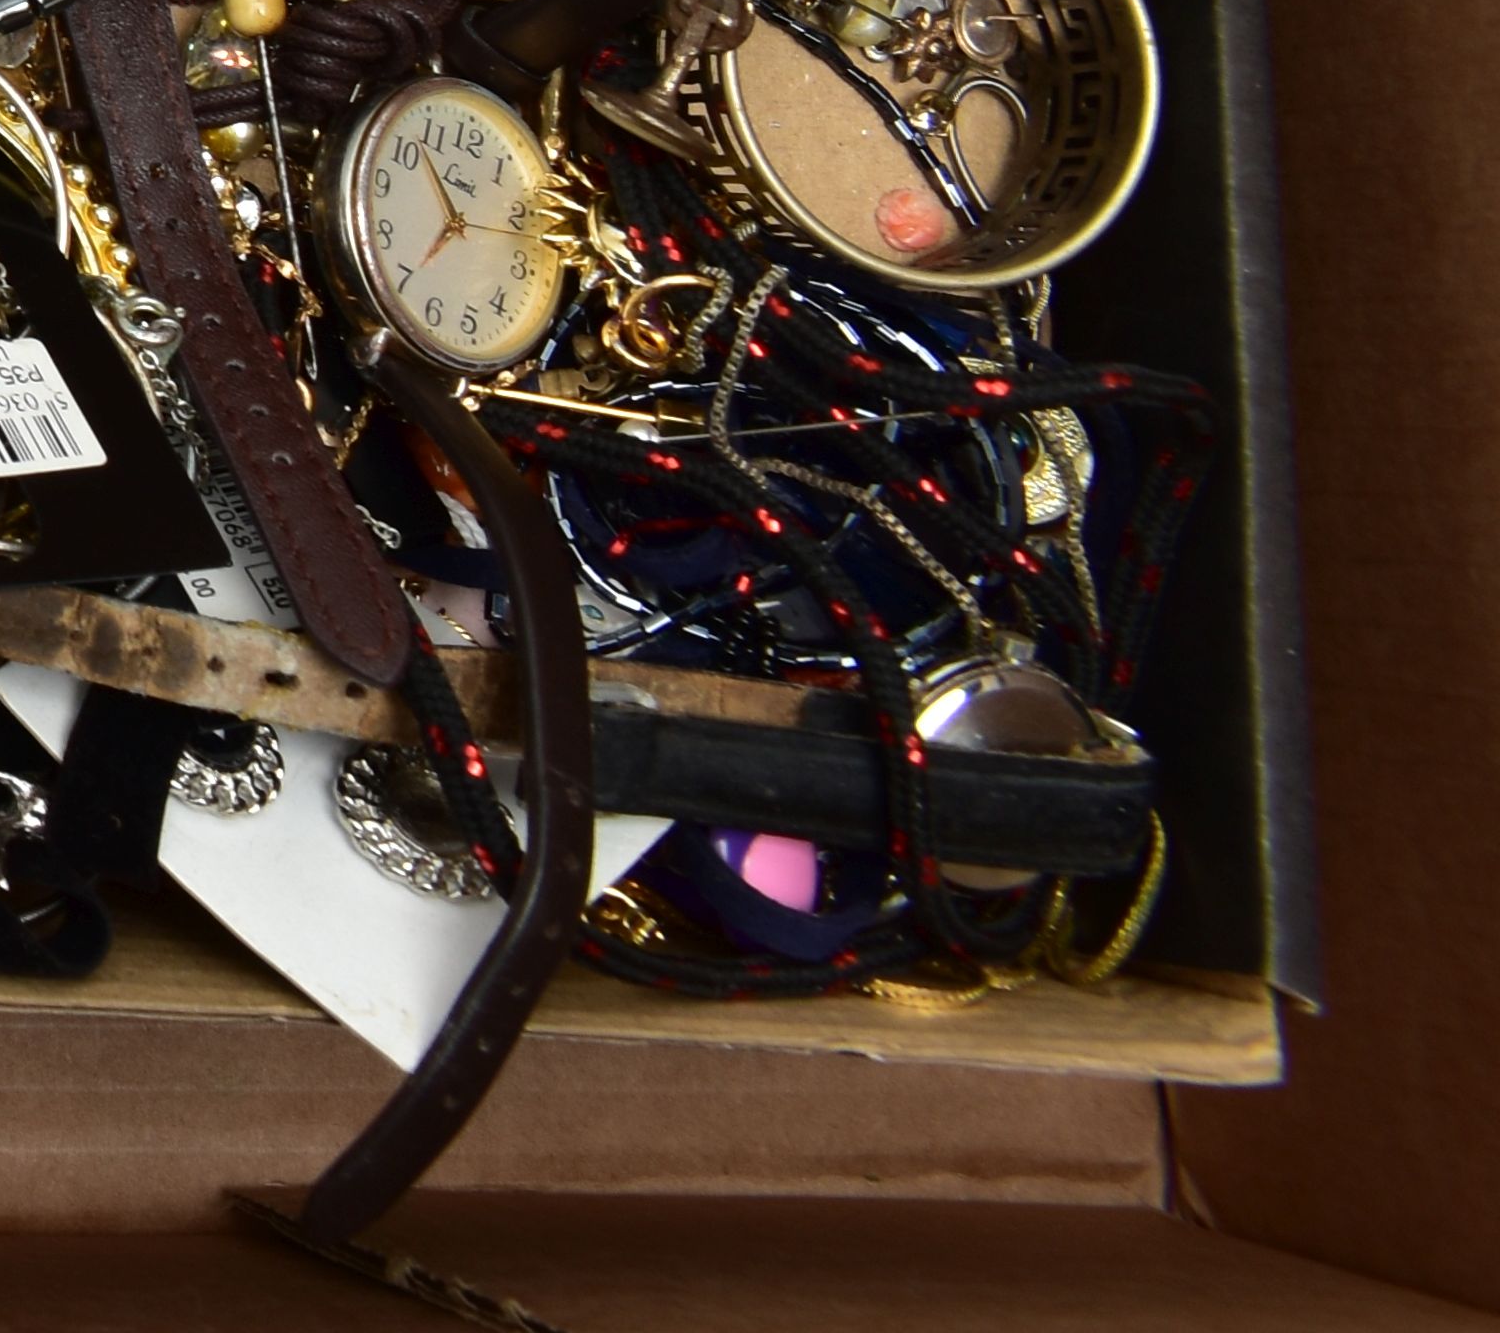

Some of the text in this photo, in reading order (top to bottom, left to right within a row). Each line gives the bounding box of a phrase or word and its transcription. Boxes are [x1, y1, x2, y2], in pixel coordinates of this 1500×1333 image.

[420, 118, 446, 155] 11
[452, 121, 484, 159] 12
[391, 135, 419, 170] 10
[375, 169, 391, 198] 9
[491, 157, 504, 187] 1
[508, 201, 526, 230] 2
[376, 219, 393, 250] 8
[396, 263, 414, 294] 7
[510, 250, 528, 280] 3
[425, 297, 443, 327] 6
[488, 286, 507, 319] 4
[460, 304, 478, 335] 5
